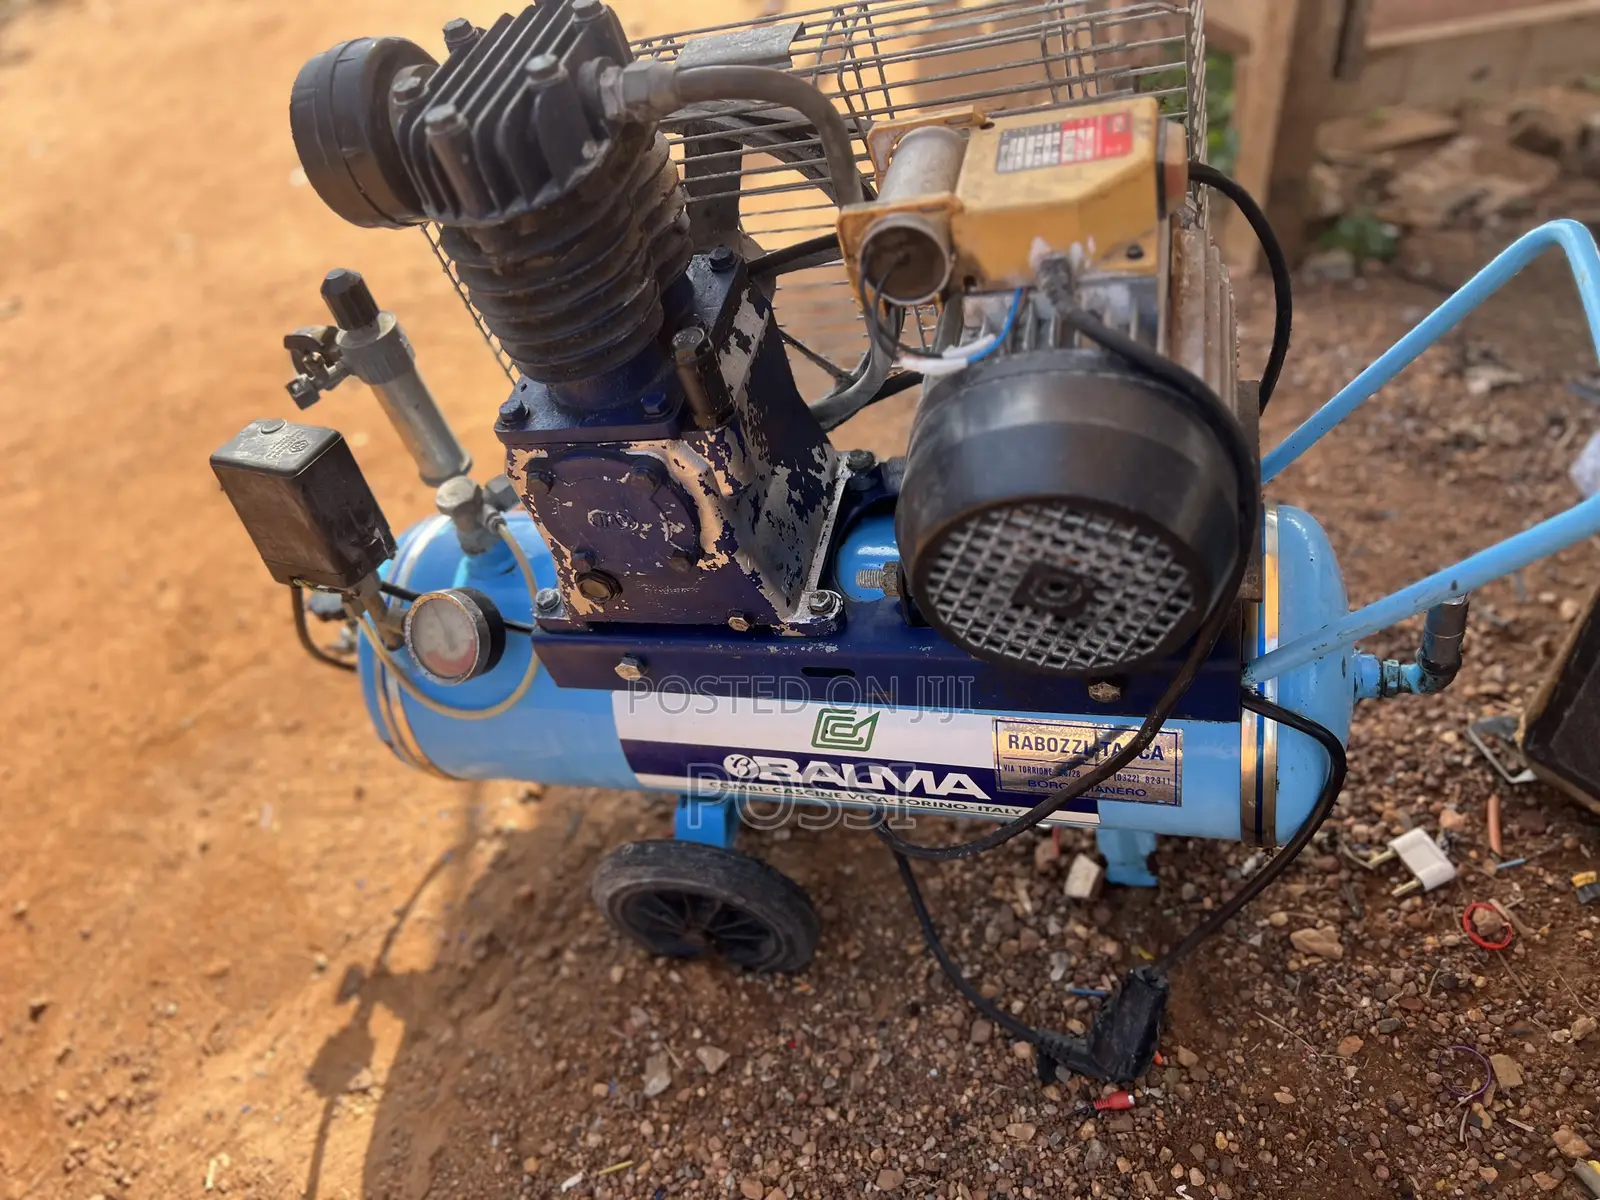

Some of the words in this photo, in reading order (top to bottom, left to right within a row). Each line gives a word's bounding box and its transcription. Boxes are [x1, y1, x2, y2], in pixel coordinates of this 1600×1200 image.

[1008, 734, 1165, 762] RABOZZI-TACA
[1003, 764, 1015, 773] VIA
[1018, 765, 1053, 777] TORRIONE
[1145, 776, 1171, 786] 82311
